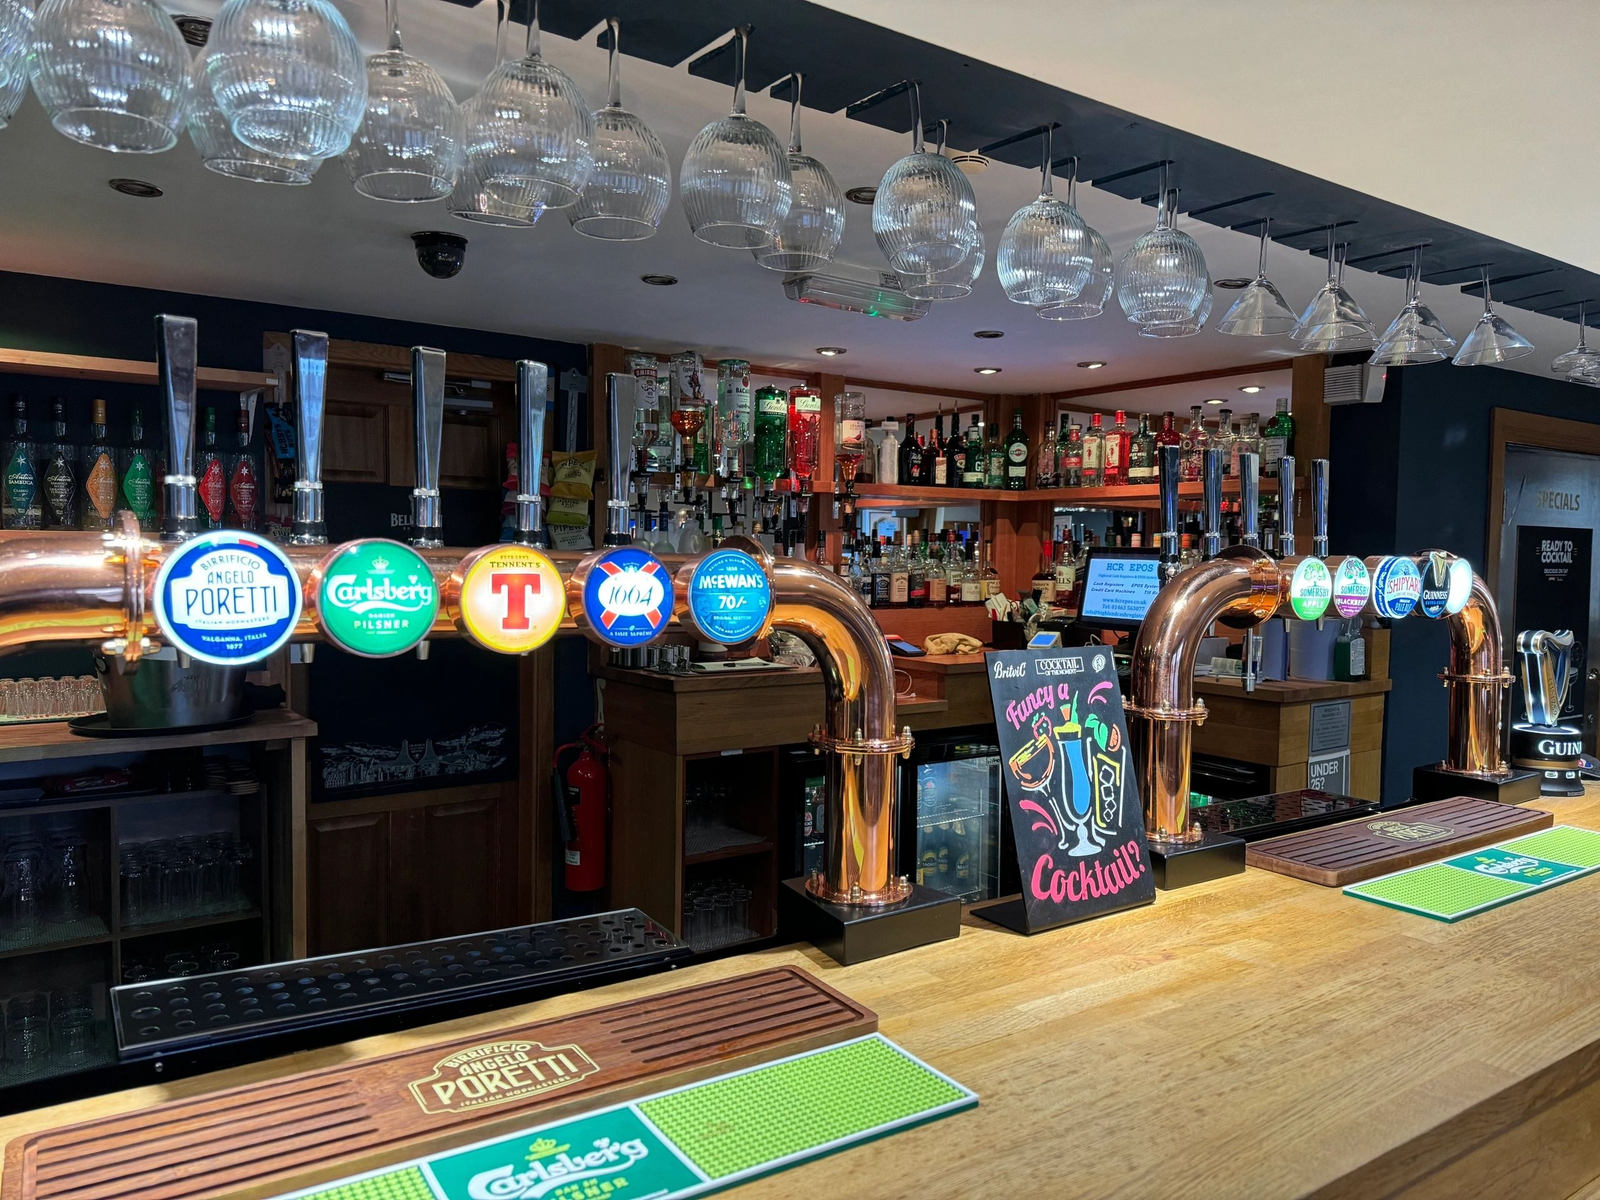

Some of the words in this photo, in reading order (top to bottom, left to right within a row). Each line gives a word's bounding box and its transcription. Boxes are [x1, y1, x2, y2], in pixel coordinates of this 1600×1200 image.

[1536, 490, 1580, 512] SPECIALS
[1541, 540, 1563, 551] READY
[1564, 540, 1573, 552] TO
[200, 554, 260, 570] BIRRIFICIO
[1541, 552, 1572, 563] COCKTAIL
[1106, 563, 1124, 571] HCR
[1129, 563, 1154, 572] EPOS
[208, 571, 254, 584] ANGELO
[1389, 576, 1420, 594] SHIPYAR
[326, 574, 432, 611] Carlsberg
[1300, 588, 1329, 597] SOMERSBY
[1341, 586, 1369, 595] SOMERSBY
[1424, 590, 1448, 600] GUINNESS
[186, 586, 277, 616] PORETTI
[492, 574, 541, 629] T
[718, 596, 747, 609] 70/-
[354, 620, 409, 629] PILSNER
[1040, 658, 1079, 670] COCKTAIL
[1006, 685, 1054, 730] Fancy
[1058, 683, 1069, 700] a
[1310, 761, 1338, 777] UNDER
[1311, 777, 1325, 790] 25?
[1031, 840, 1146, 903] Cocktail?
[444, 1044, 532, 1068] BIRRIFICIO
[460, 1051, 529, 1076] ANGELO
[432, 1053, 578, 1105] PORETTI
[460, 1094, 503, 1107] ITALIAN
[506, 1076, 571, 1097] HOPMASTERS
[468, 1138, 649, 1200] Carlsberg
